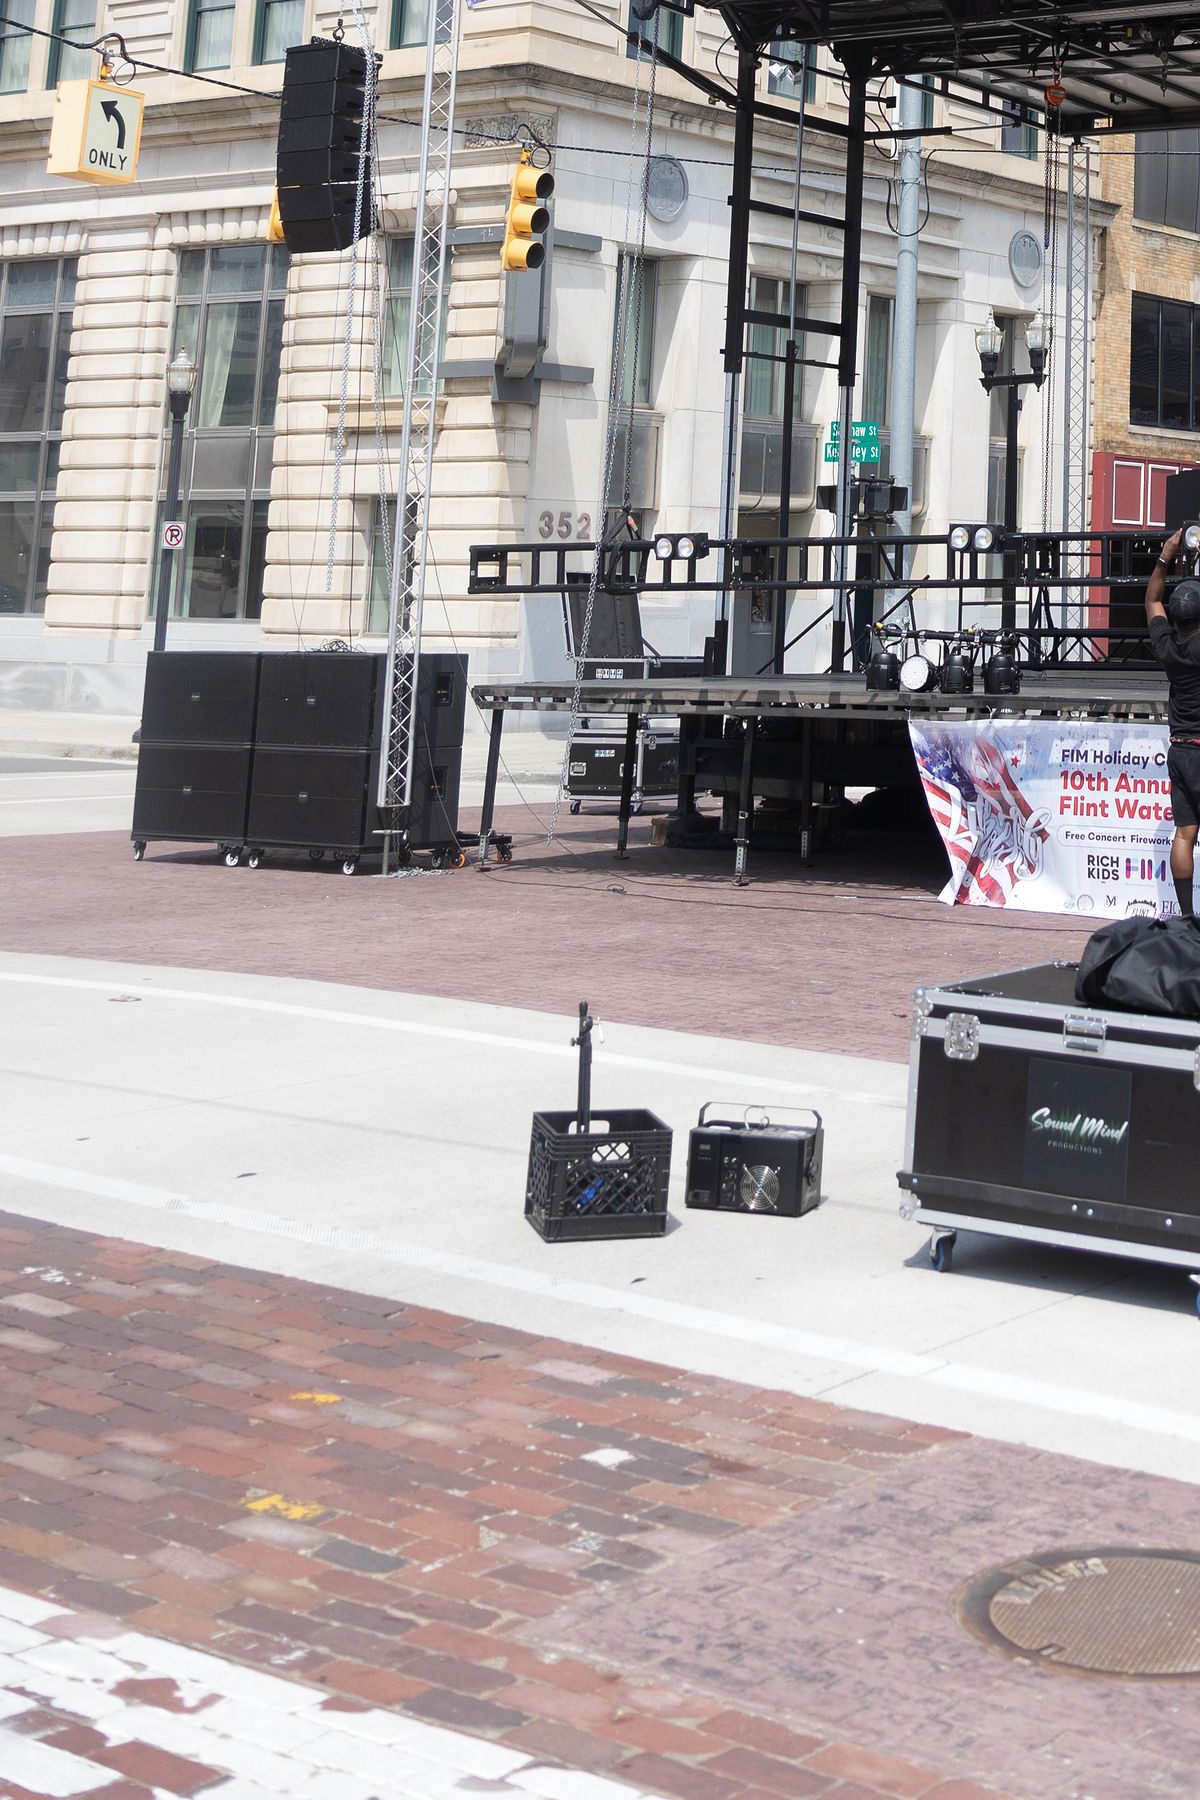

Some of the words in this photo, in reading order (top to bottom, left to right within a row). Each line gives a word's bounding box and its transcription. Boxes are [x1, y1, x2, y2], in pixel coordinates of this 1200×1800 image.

[89, 148, 128, 171] ONLY
[832, 424, 866, 437] Snaw
[868, 426, 877, 436] St
[826, 444, 867, 461] Kealey
[870, 446, 879, 458] St
[539, 510, 591, 539] 352
[1061, 749, 1088, 763] FIM
[1093, 750, 1150, 769] Holiday
[1060, 770, 1108, 792] 10th
[1115, 772, 1172, 795] Annu
[1059, 795, 1109, 817] Flint
[1115, 798, 1175, 821] Wate
[1065, 831, 1085, 840] Free
[1088, 832, 1126, 843] Concert
[1087, 854, 1119, 868] RICH
[1125, 857, 1166, 882] FIM
[1087, 867, 1119, 880] KIDS
[1031, 1107, 1082, 1136] Sound
[1080, 1117, 1129, 1144] Mind
[1047, 1140, 1103, 1155] PRODUCTIONS
